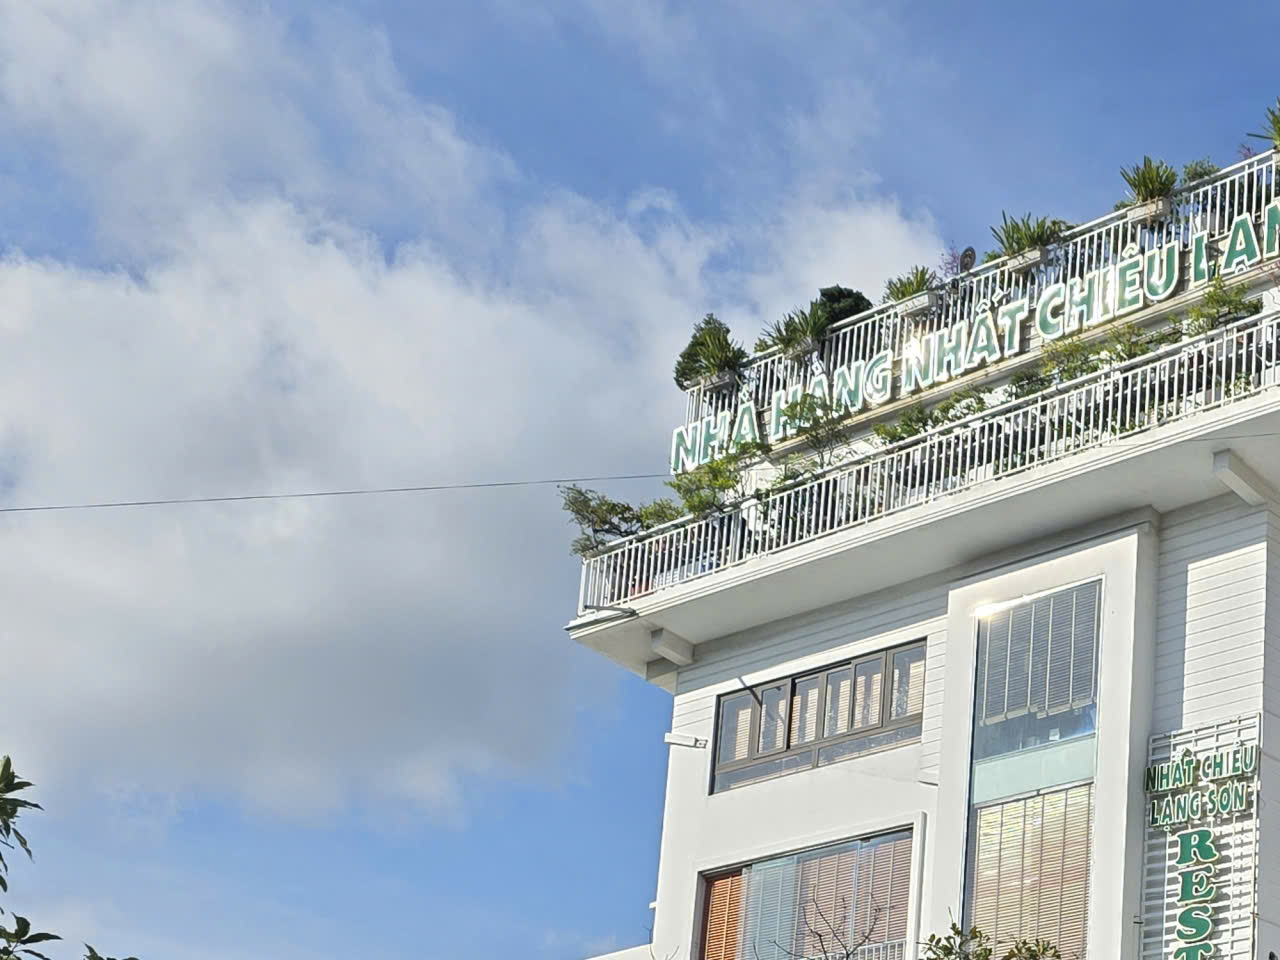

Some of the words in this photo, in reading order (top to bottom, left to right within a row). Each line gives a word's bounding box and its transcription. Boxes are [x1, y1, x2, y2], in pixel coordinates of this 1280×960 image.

[902, 288, 1028, 392] NHẤT
[1036, 240, 1180, 340] CHIÊU
[1150, 790, 1201, 831] LẠNG
[1207, 780, 1247, 816] SƠN
